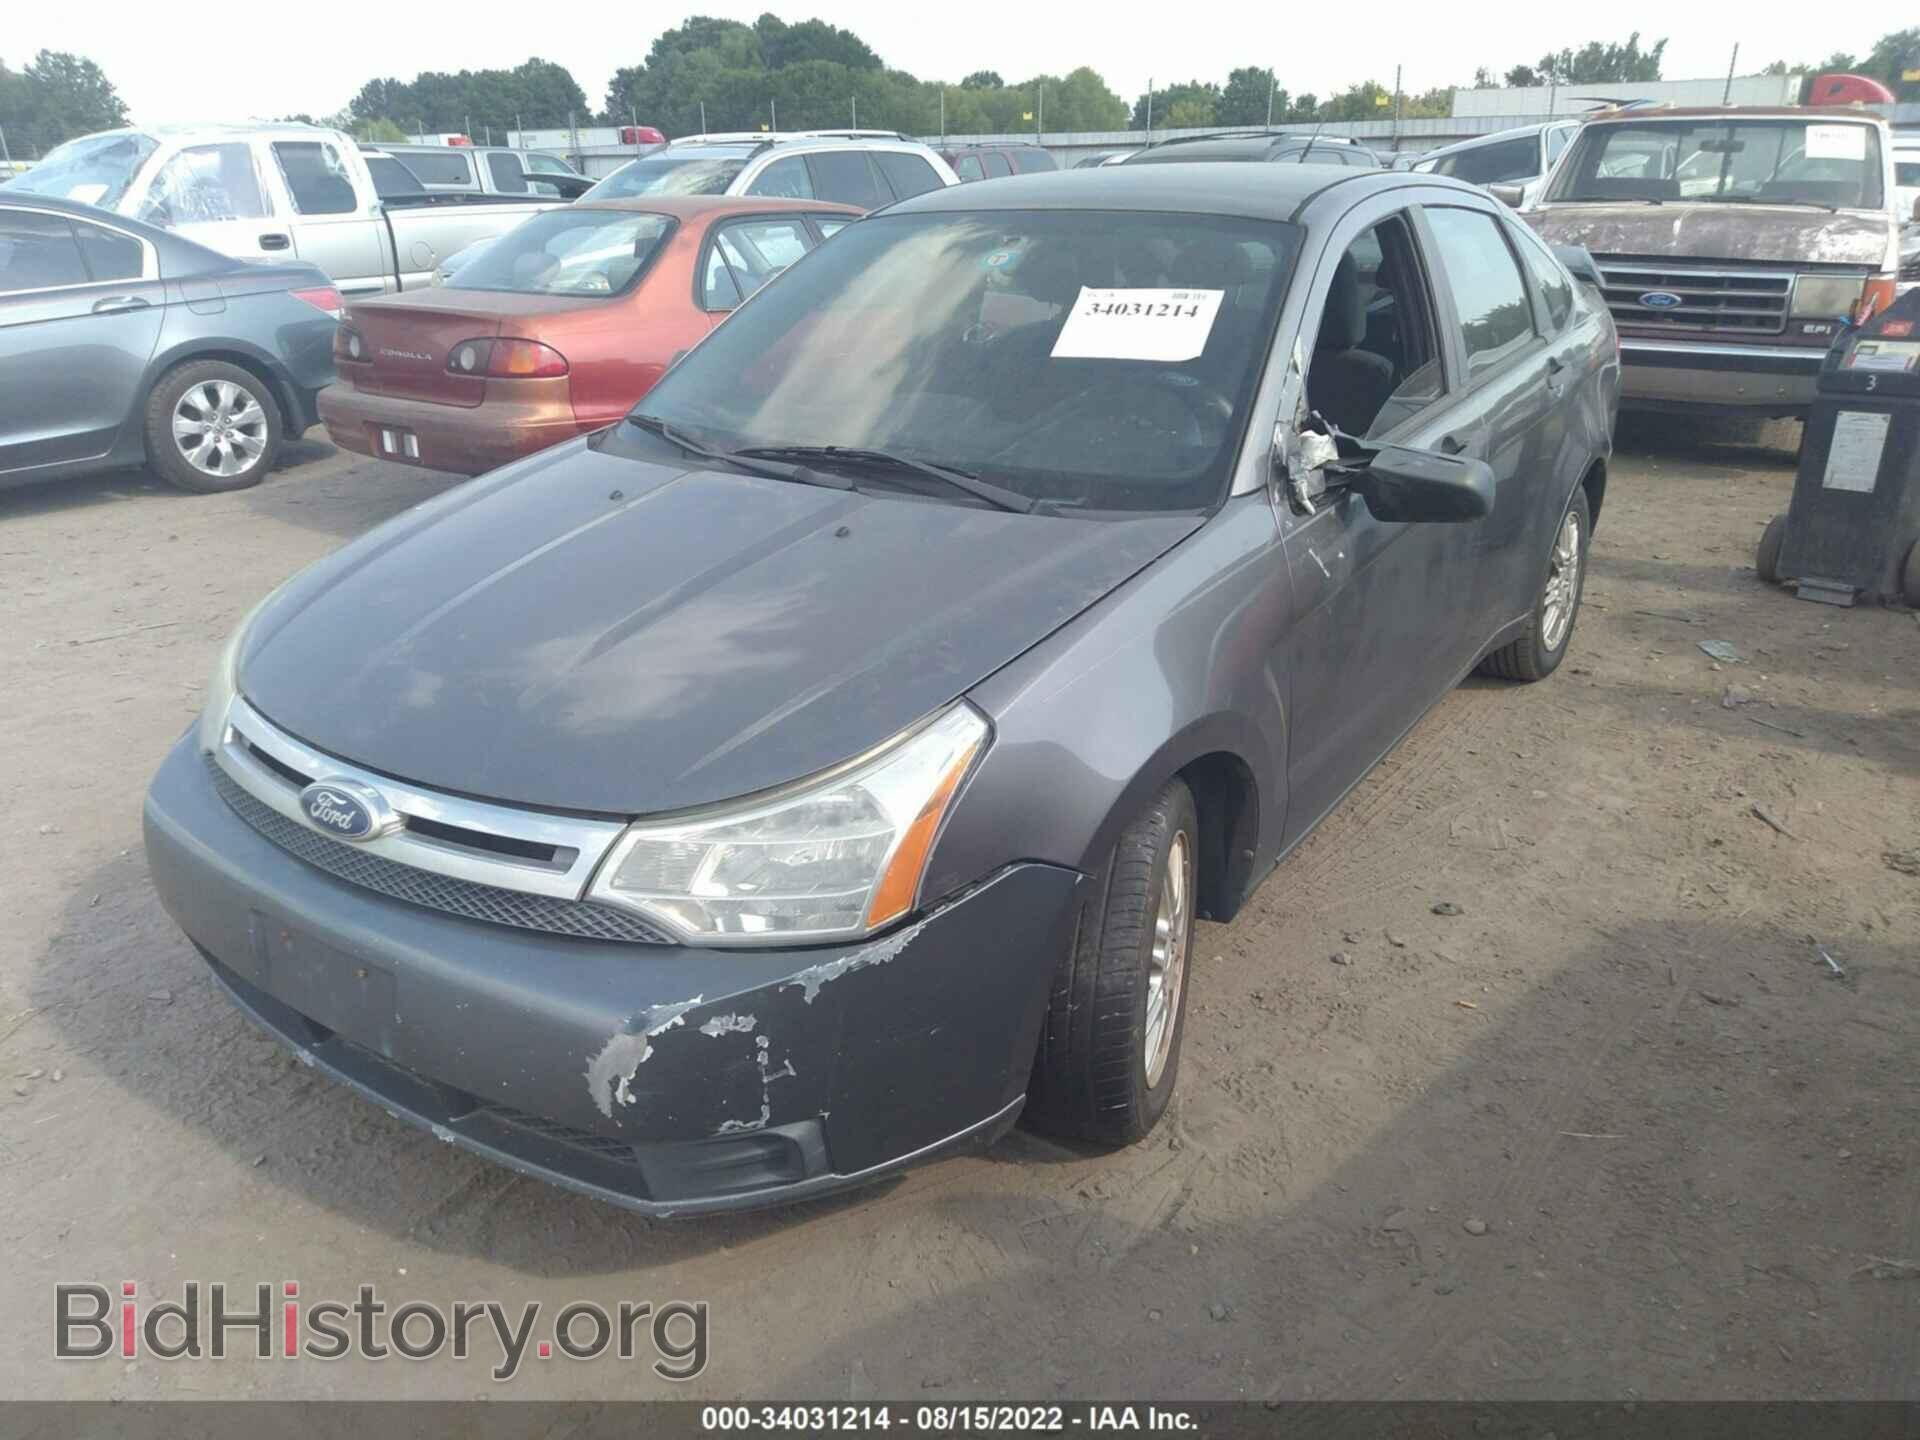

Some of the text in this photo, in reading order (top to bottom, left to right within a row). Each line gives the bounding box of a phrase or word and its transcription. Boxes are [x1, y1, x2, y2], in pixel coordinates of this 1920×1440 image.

[1084, 302, 1200, 318] 34031214
[1865, 374, 1877, 391] 3
[310, 791, 357, 830] Ford
